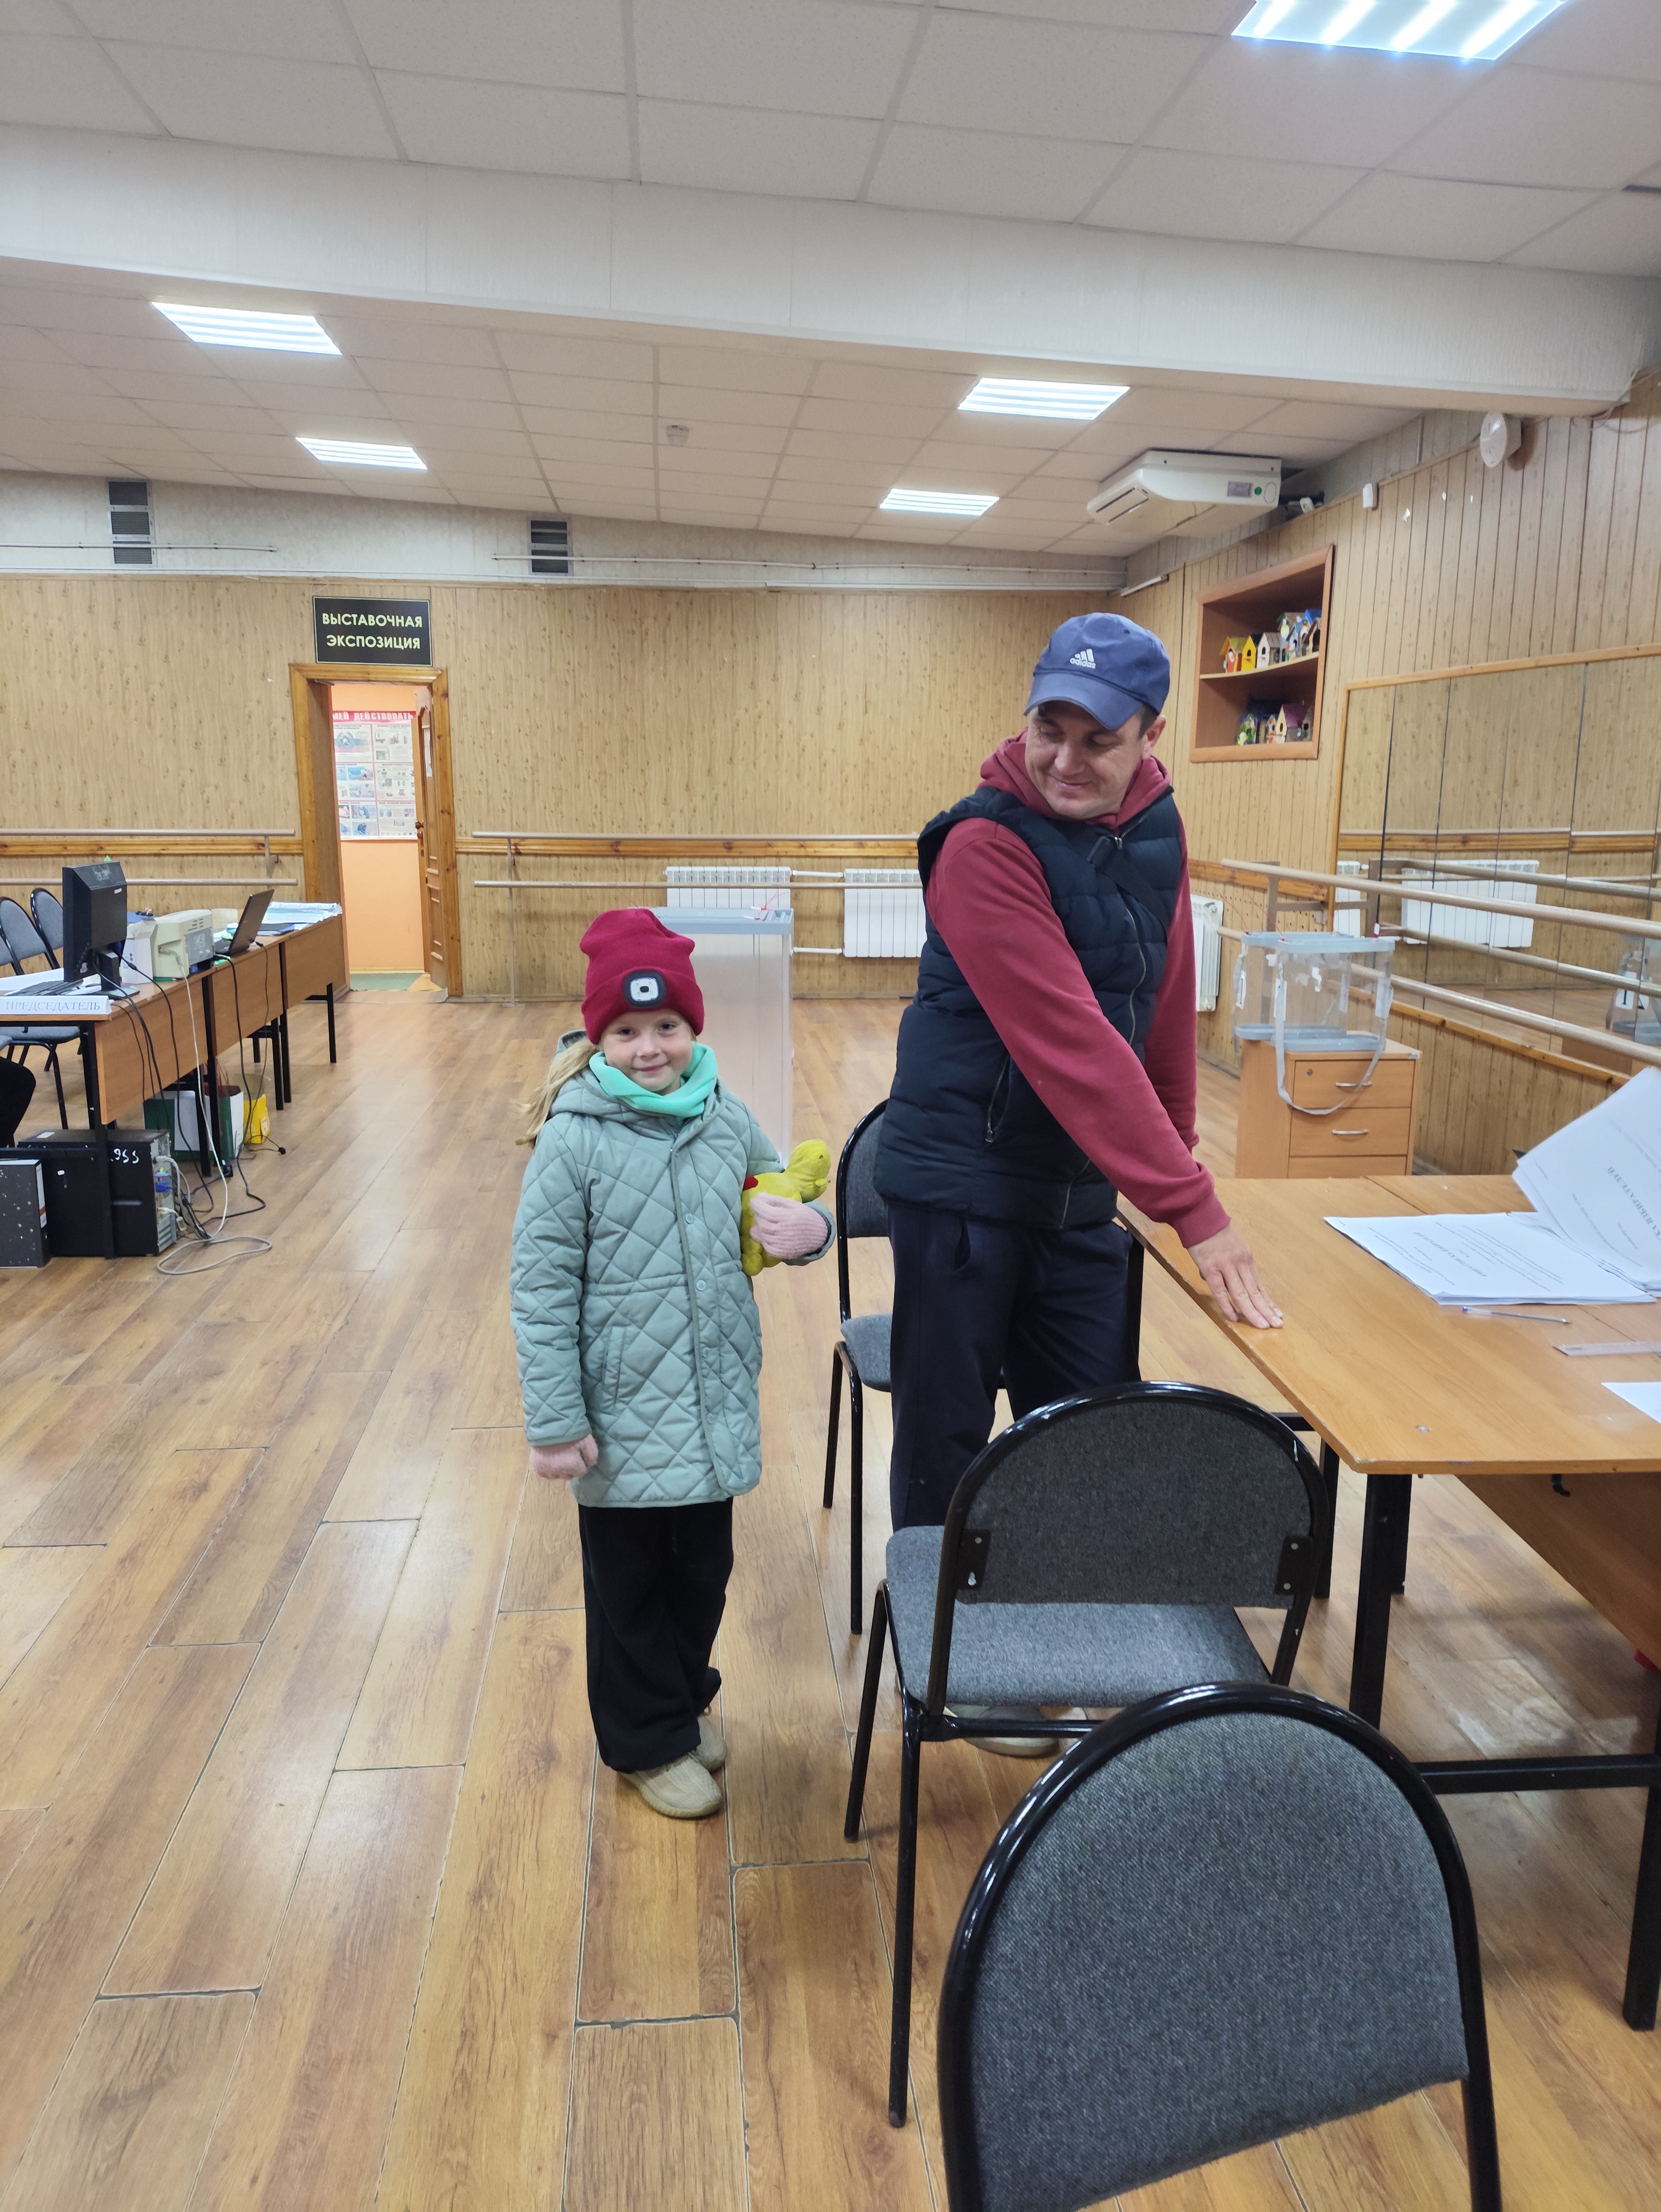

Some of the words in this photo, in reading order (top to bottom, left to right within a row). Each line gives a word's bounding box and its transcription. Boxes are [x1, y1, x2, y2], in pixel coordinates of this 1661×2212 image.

[322, 613, 422, 628] ВЫСТАВОЧНАЯ
[326, 635, 421, 650] ЭКСПОЗИЦИЯ
[1070, 658, 1096, 669] adidas
[354, 712, 413, 721] ДЕЙСТВОВАТЬ
[6, 1001, 100, 1012] ПРЕДСЕДАТЕЛЬ
